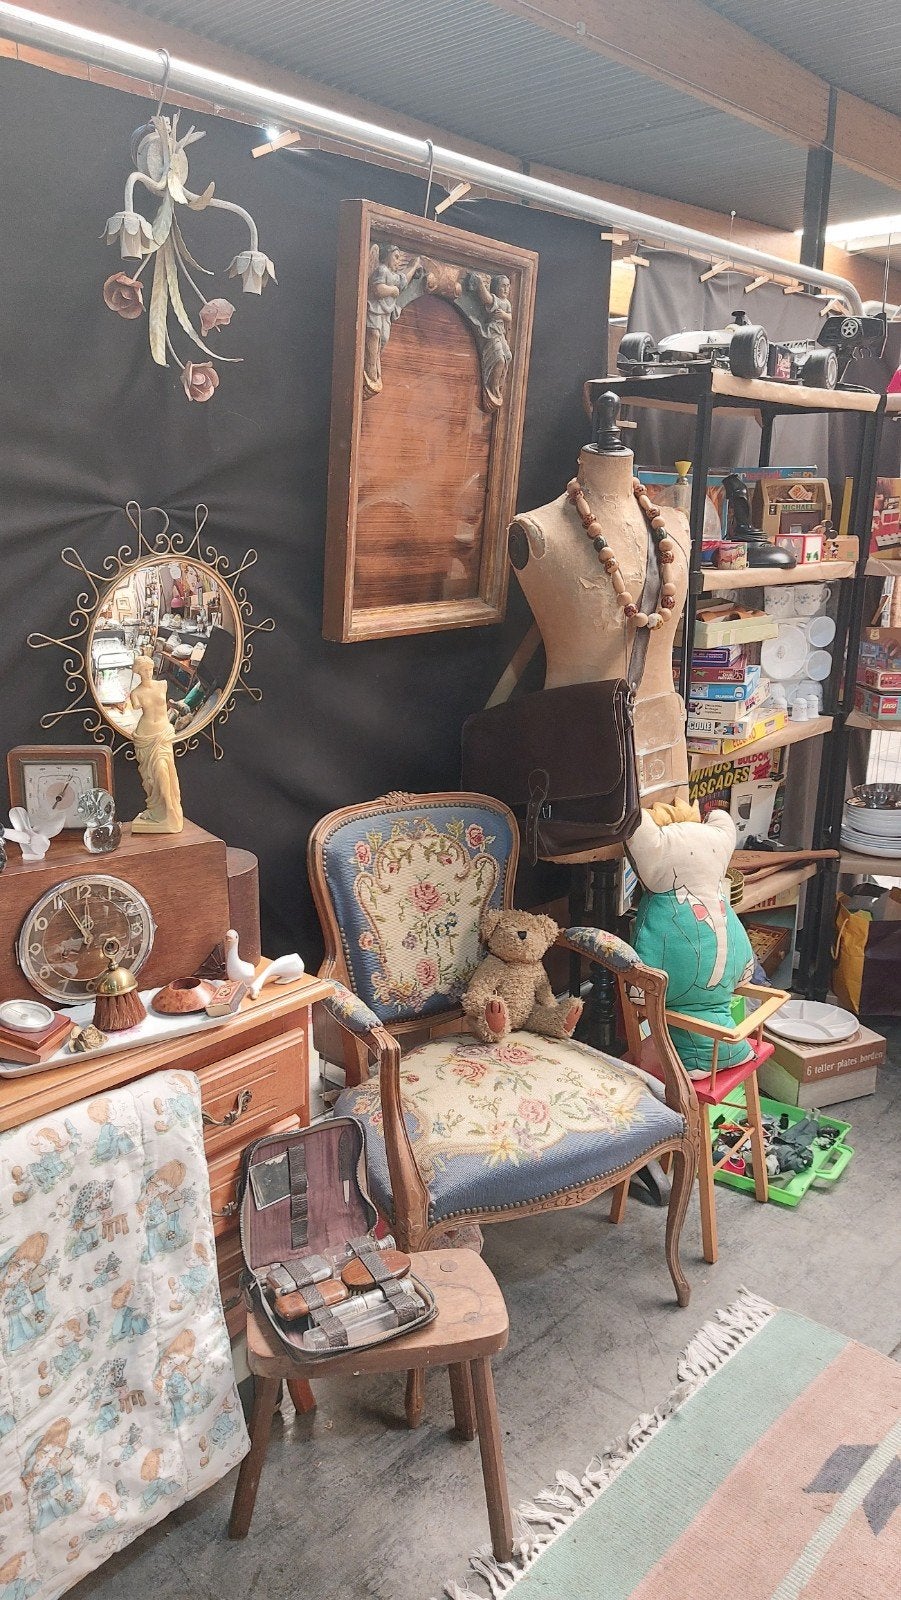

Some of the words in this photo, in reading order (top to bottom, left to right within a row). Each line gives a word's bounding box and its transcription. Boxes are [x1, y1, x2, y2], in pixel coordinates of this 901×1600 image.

[782, 503, 813, 511] MICHAEL
[687, 766, 750, 800] ASCADES
[76, 884, 91, 901] 12
[34, 917, 48, 932] 10
[806, 1065, 812, 1076] 6
